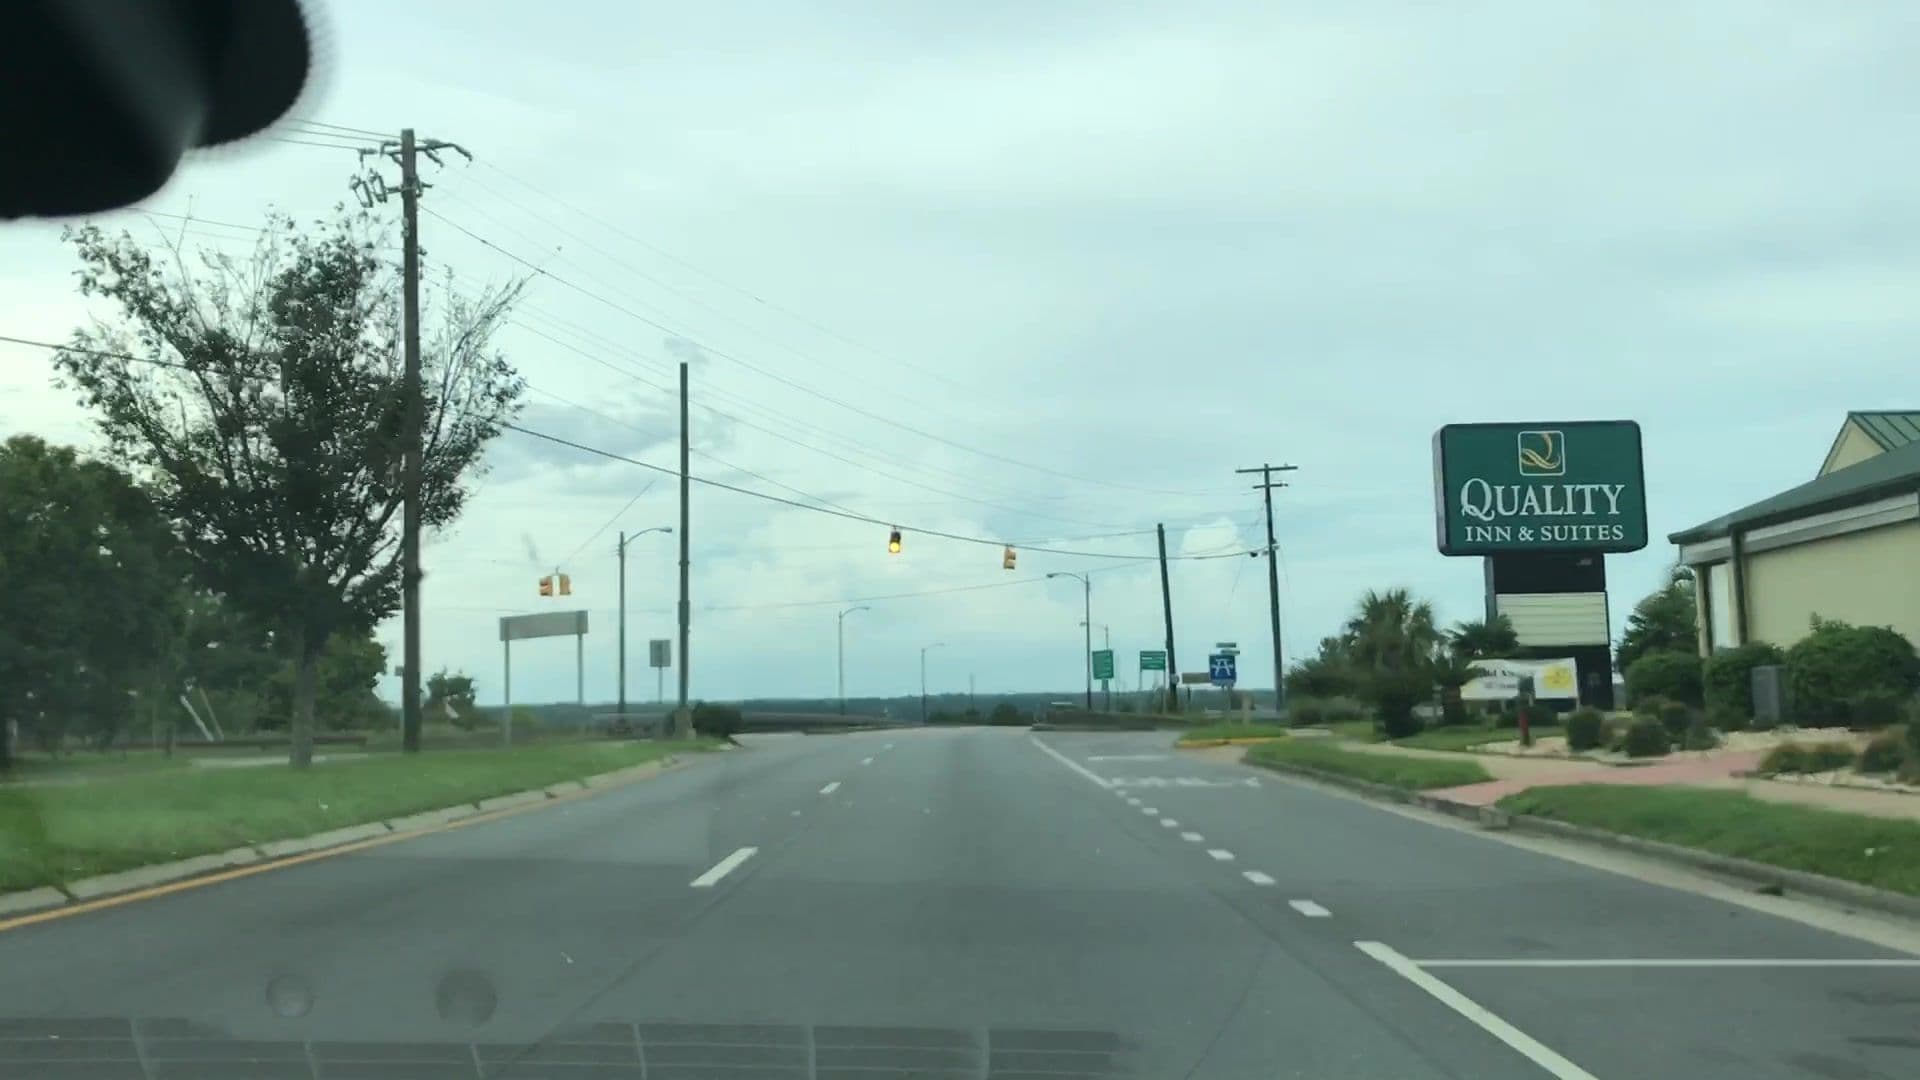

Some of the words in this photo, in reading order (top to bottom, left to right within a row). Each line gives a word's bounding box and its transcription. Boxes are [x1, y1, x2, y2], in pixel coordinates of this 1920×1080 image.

[1460, 478, 1625, 521] QUALITY
[1465, 526, 1512, 542] INN
[1518, 526, 1535, 542] &
[1540, 524, 1624, 541] SUITES
